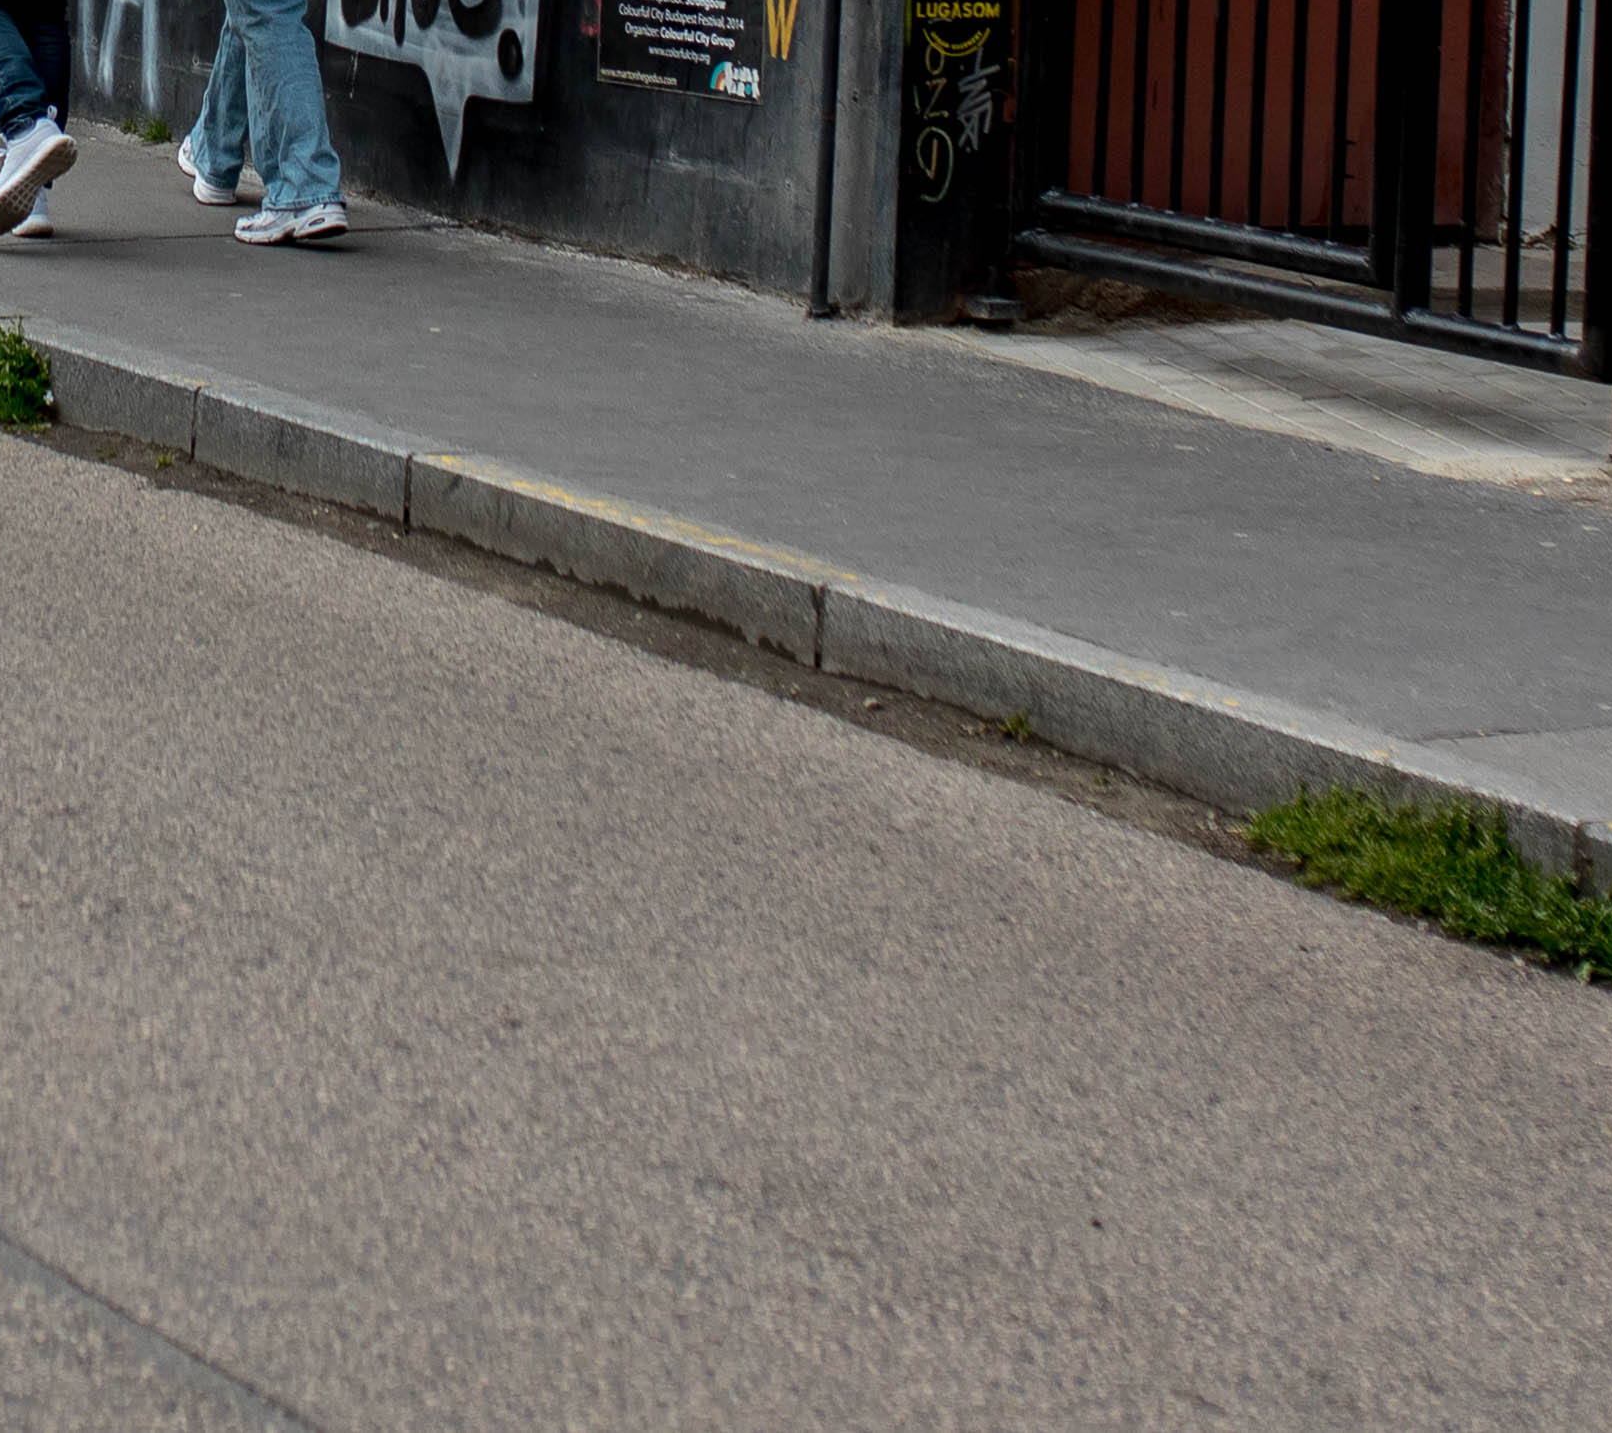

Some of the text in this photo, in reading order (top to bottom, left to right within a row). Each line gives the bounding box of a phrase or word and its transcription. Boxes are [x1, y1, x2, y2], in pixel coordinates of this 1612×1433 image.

[618, 3, 650, 18] Colourful
[651, 8, 664, 22] City
[665, 9, 697, 25] Budapest
[726, 17, 744, 30] 2014
[916, 1, 1000, 19] LUGASOM
[660, 27, 694, 42] Colourful
[696, 31, 709, 46] City
[711, 34, 735, 50] Group
